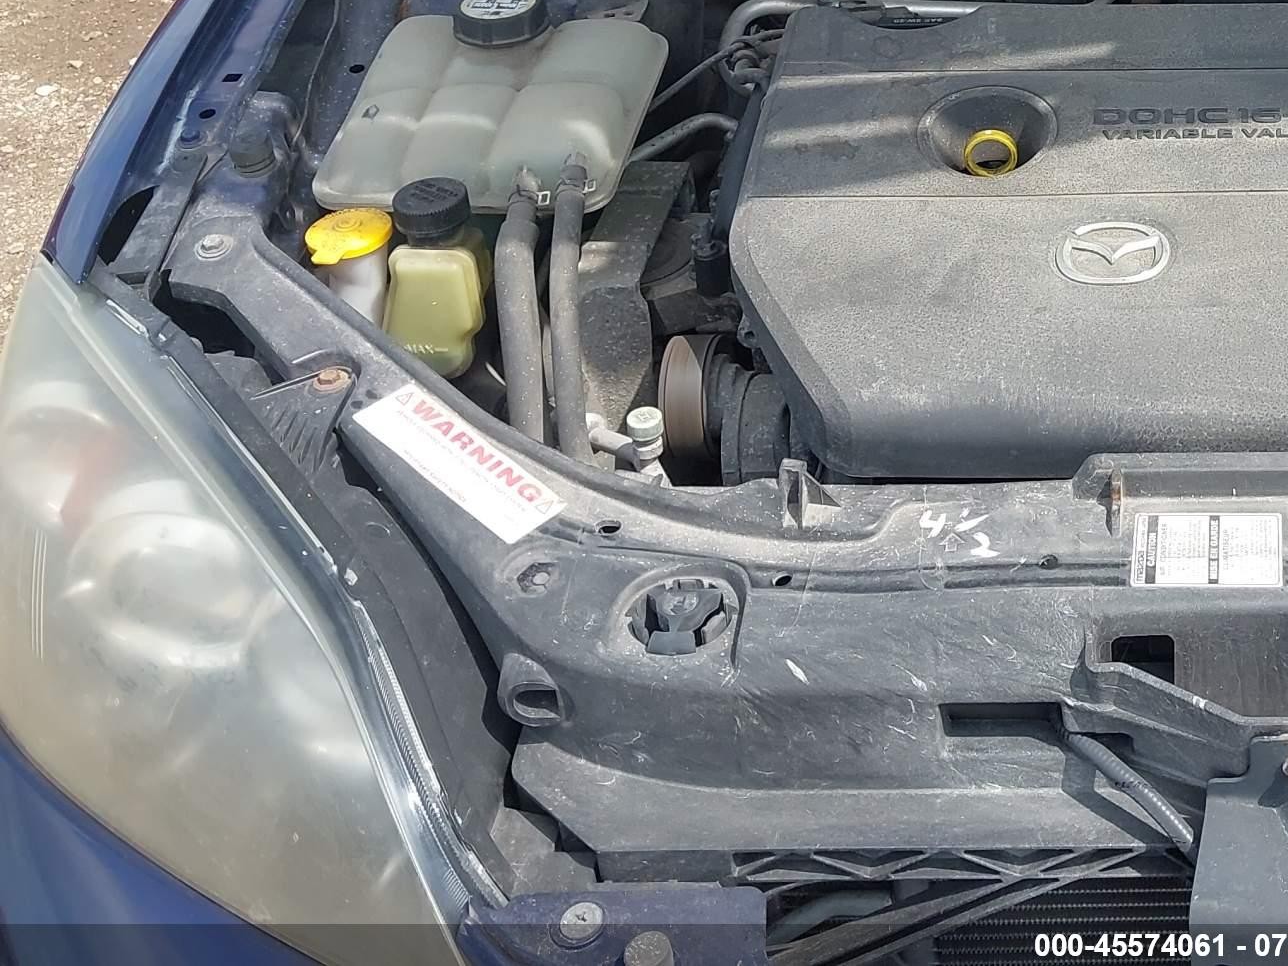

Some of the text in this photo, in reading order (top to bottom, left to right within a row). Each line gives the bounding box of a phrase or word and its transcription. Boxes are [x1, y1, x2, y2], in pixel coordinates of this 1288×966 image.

[1092, 107, 1229, 125] DOHC
[1102, 128, 1234, 140] VARIABLE
[412, 398, 543, 503] WARNING
[1146, 532, 1157, 567] CAUTION
